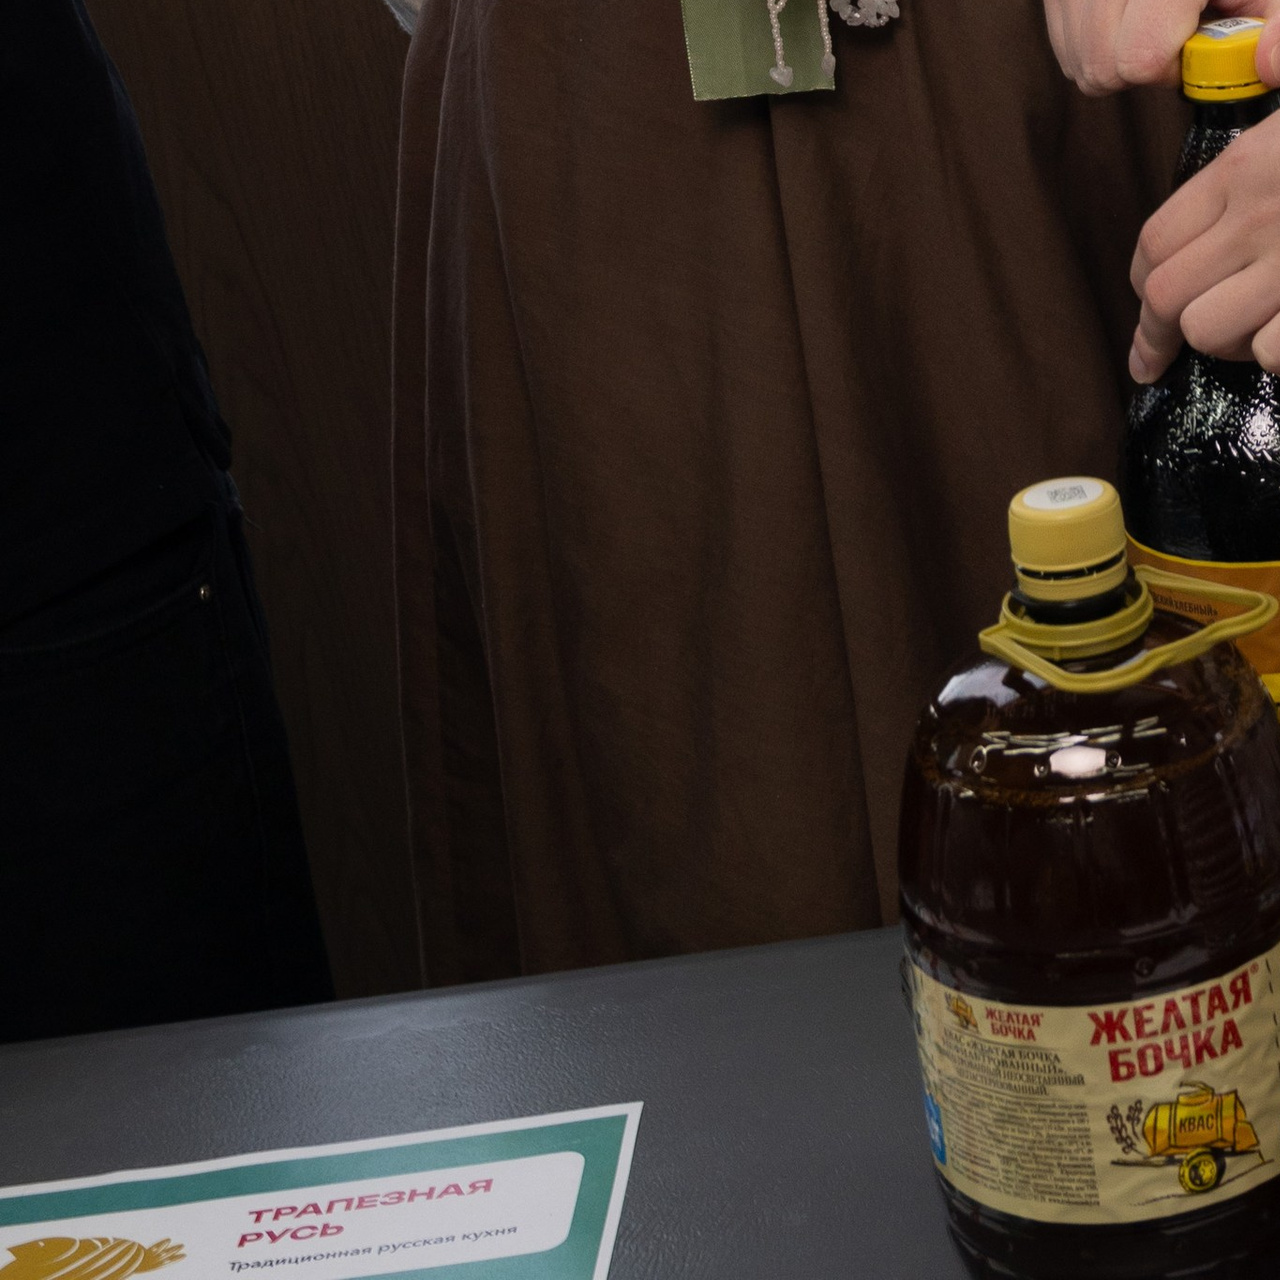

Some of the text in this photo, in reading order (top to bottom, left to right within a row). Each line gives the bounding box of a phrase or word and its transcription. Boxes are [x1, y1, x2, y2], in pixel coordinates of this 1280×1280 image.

[991, 1022, 1036, 1041] БОЧКА
[1108, 1017, 1243, 1083] БОЧКА
[1179, 1113, 1215, 1133] КВАС
[248, 1178, 494, 1224] ТРАПЕЗНАЯ
[228, 1226, 518, 1273] Традиционная русская кухня
[236, 1223, 345, 1248] РУСЬ
